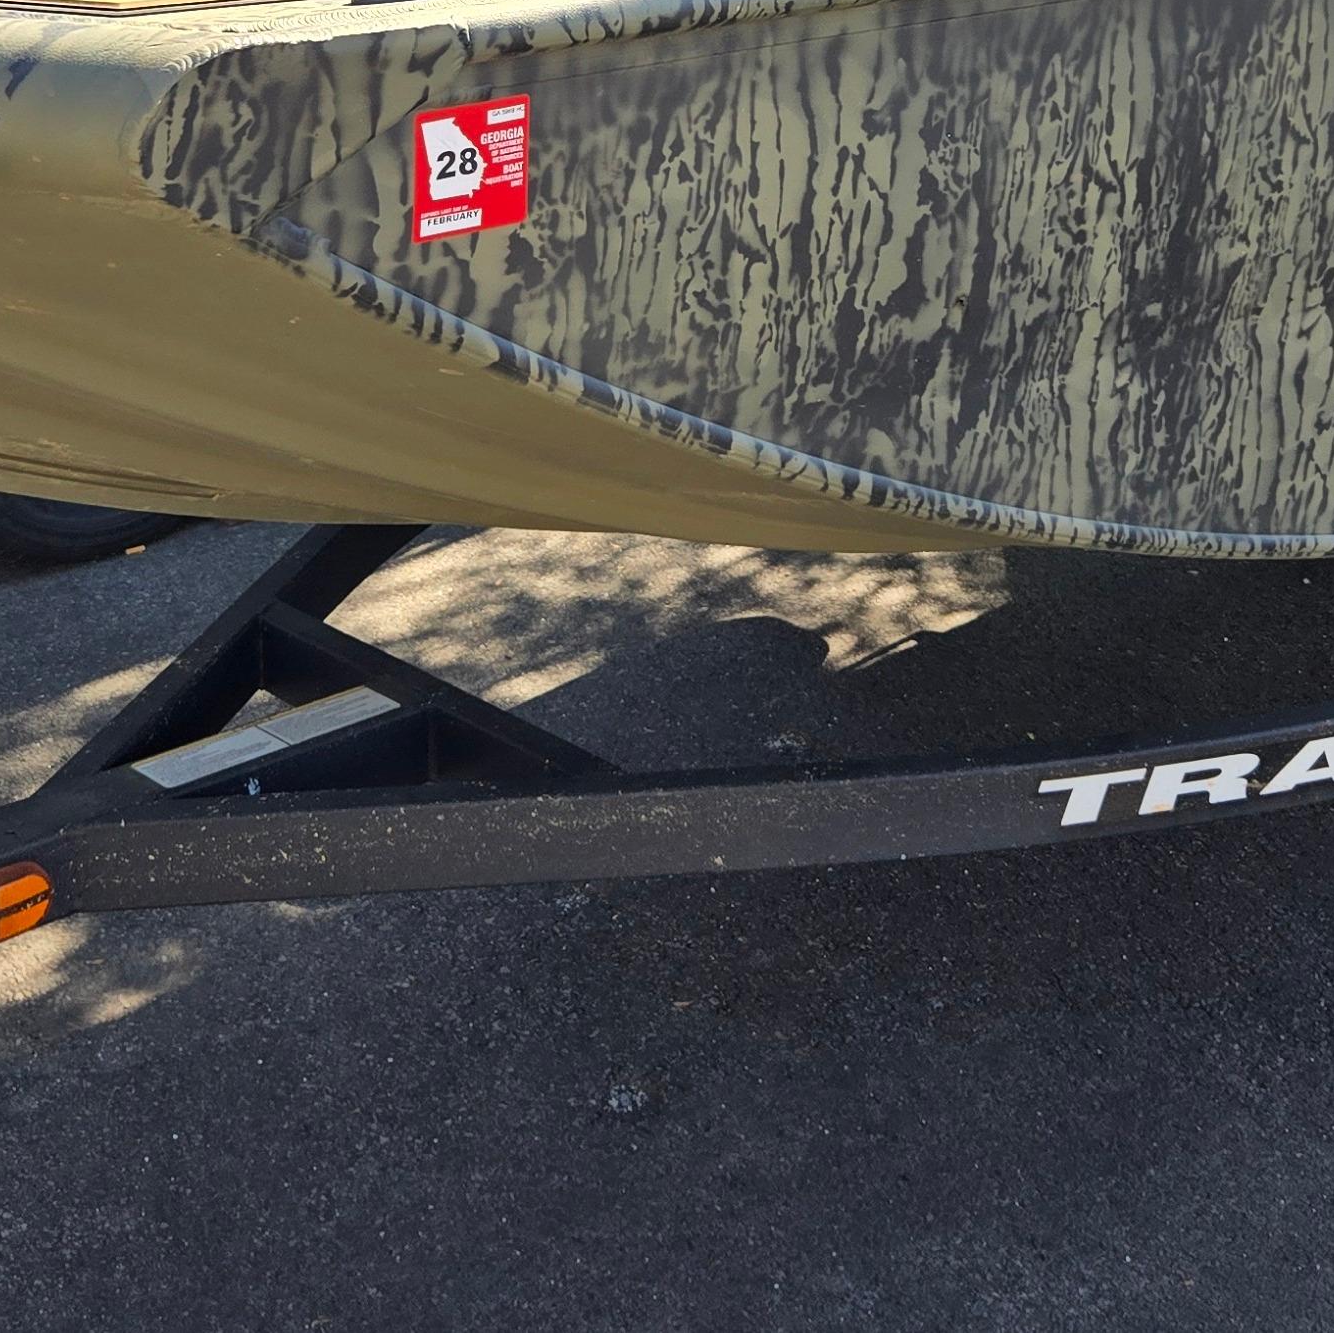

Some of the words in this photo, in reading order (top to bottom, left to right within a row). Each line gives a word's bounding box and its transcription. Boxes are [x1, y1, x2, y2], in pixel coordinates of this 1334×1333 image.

[480, 126, 524, 144] GEORGIA
[436, 147, 478, 180] 28
[502, 161, 523, 174] BOAT
[427, 210, 479, 226] FEBRUARY
